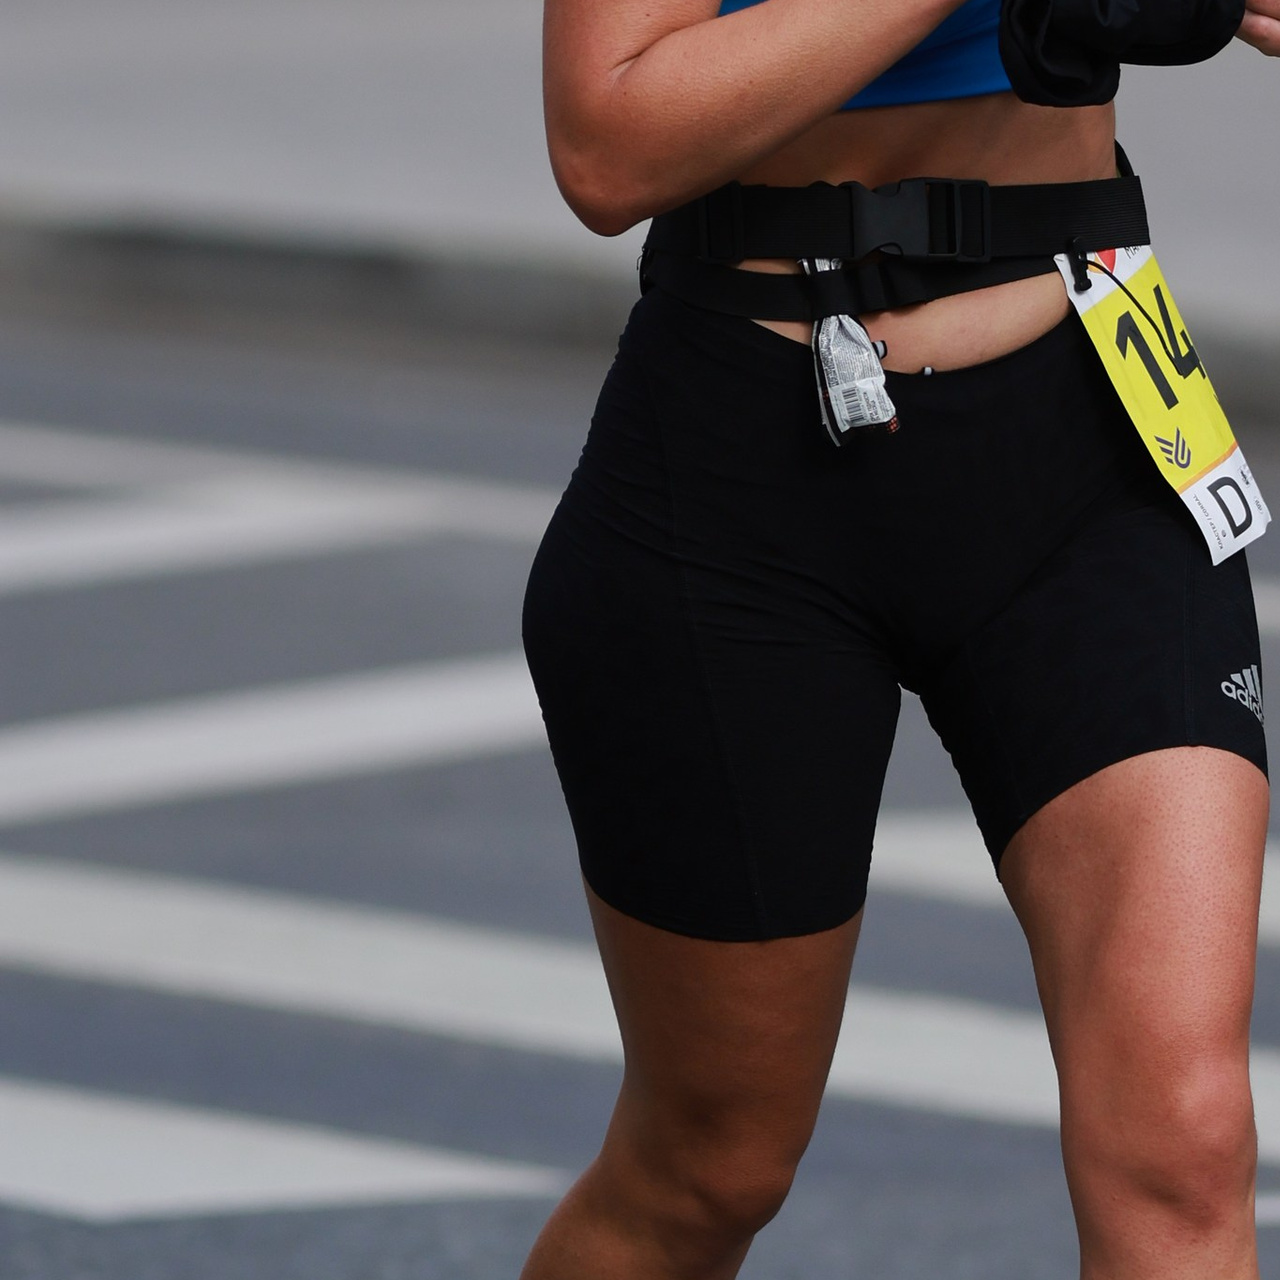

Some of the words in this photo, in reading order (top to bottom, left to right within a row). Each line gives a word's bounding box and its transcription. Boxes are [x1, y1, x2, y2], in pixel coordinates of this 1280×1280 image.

[1115, 283, 1206, 410] 14
[1206, 476, 1253, 539] D
[1221, 681, 1264, 726] adid
